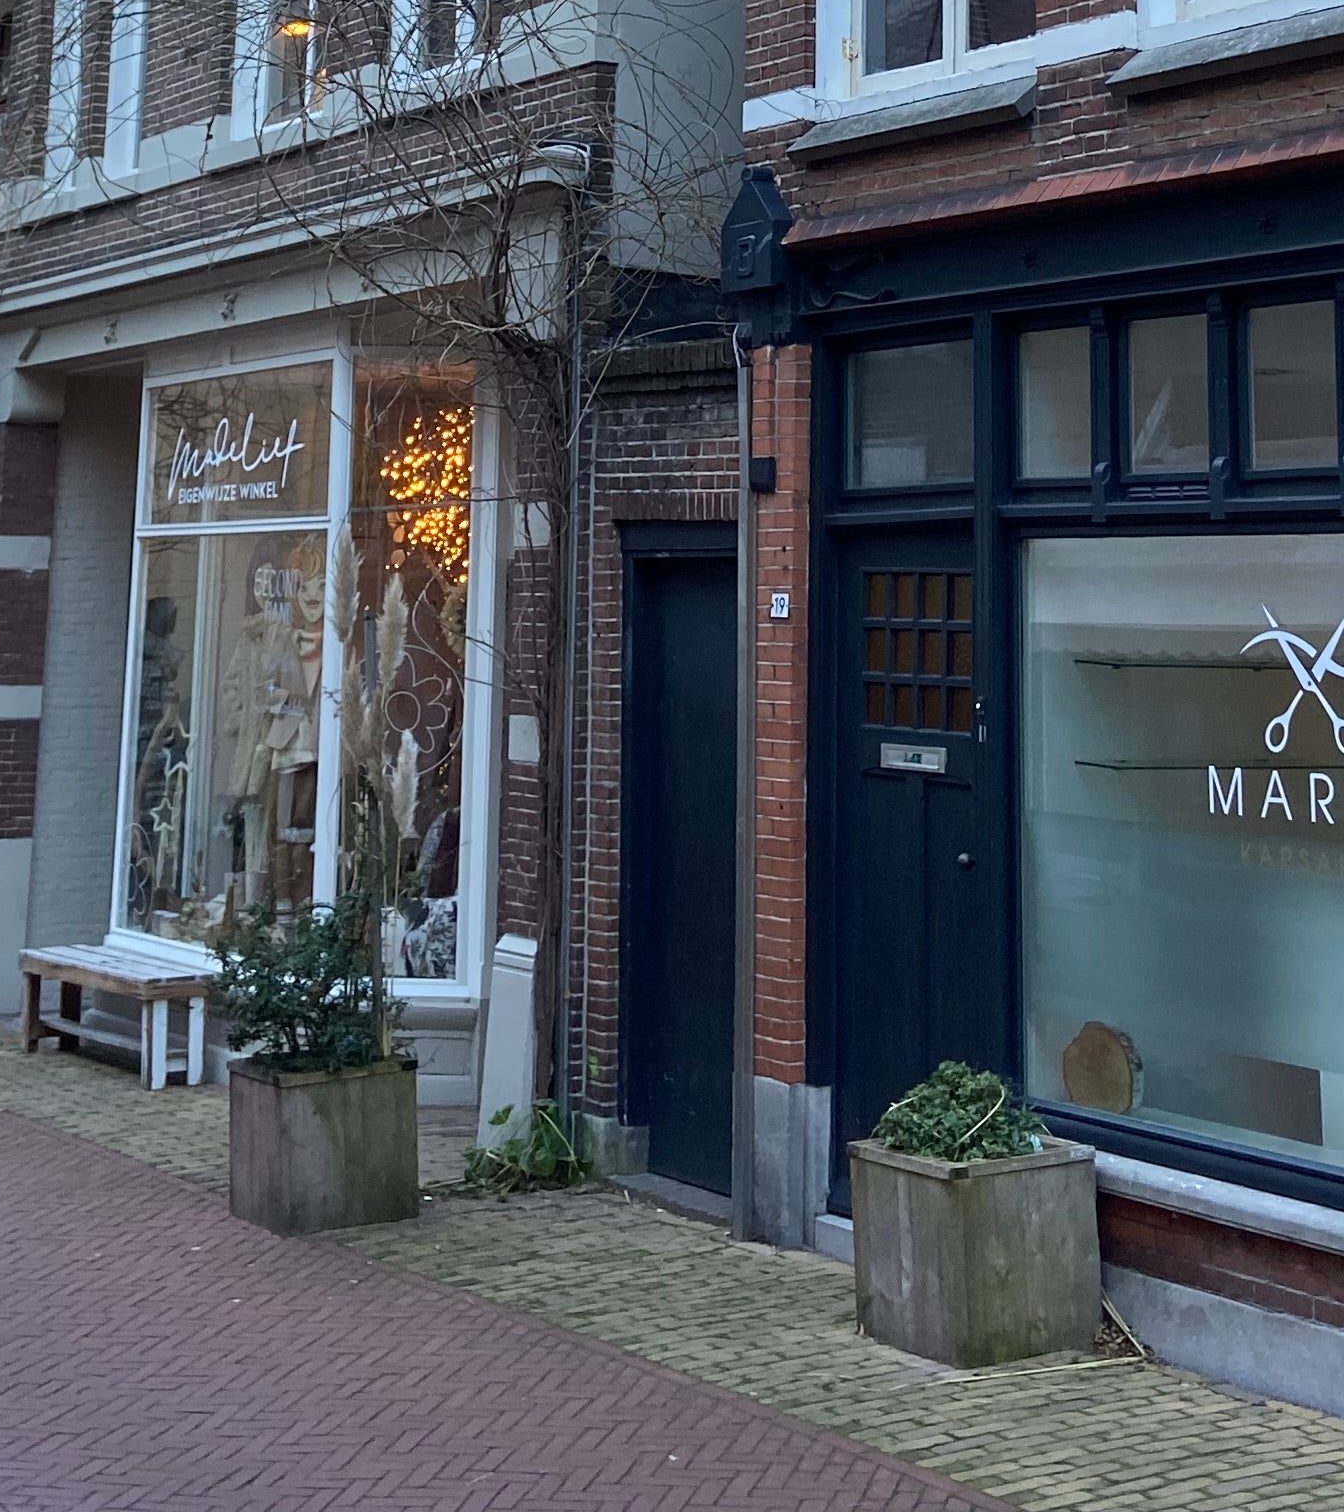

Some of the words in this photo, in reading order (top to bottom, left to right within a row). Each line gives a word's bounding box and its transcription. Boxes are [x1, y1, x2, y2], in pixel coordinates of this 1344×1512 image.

[178, 484, 236, 504] EIGENWIJZE
[239, 481, 278, 500] WINKEL
[774, 597, 786, 615] 19
